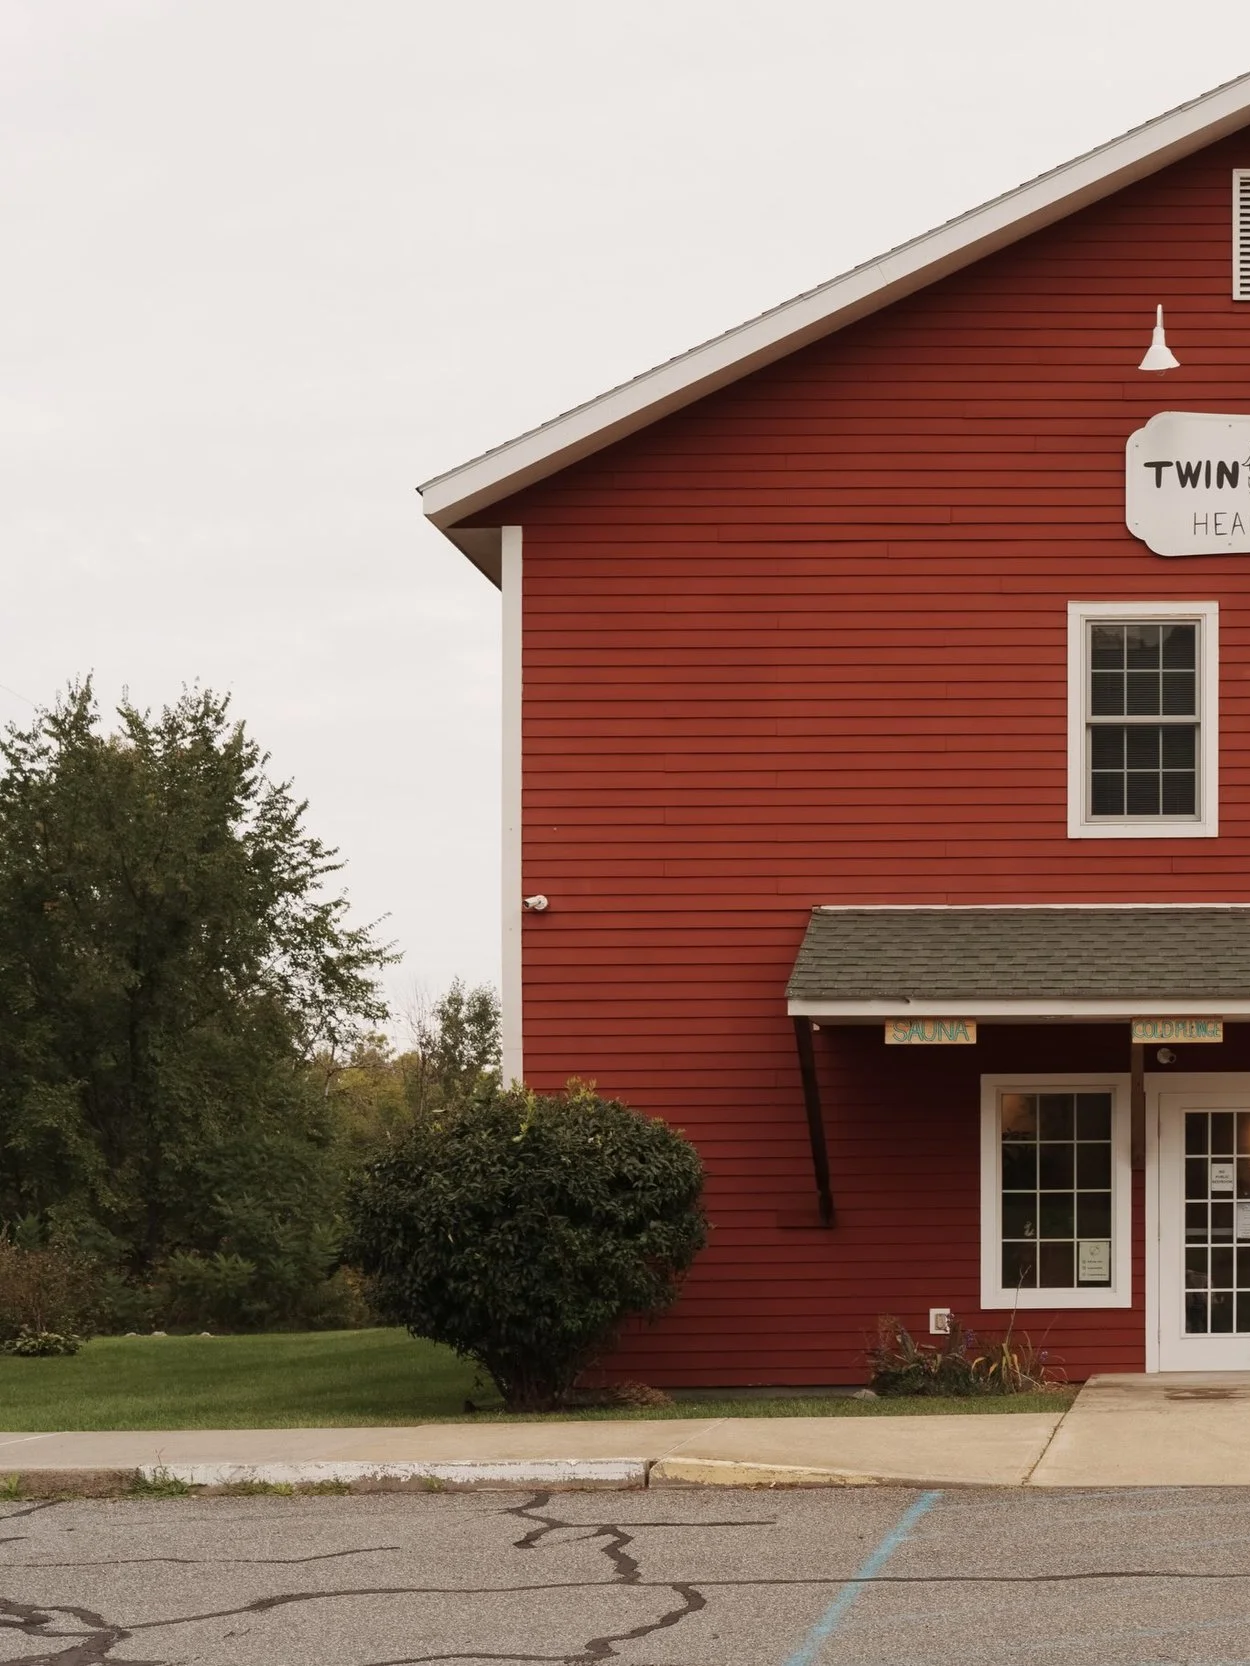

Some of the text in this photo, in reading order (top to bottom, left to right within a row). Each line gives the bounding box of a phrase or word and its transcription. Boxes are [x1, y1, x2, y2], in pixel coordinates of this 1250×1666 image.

[1143, 459, 1240, 489] TWIN
[892, 1019, 970, 1042] SAUNA
[1133, 1020, 1174, 1038] COLD
